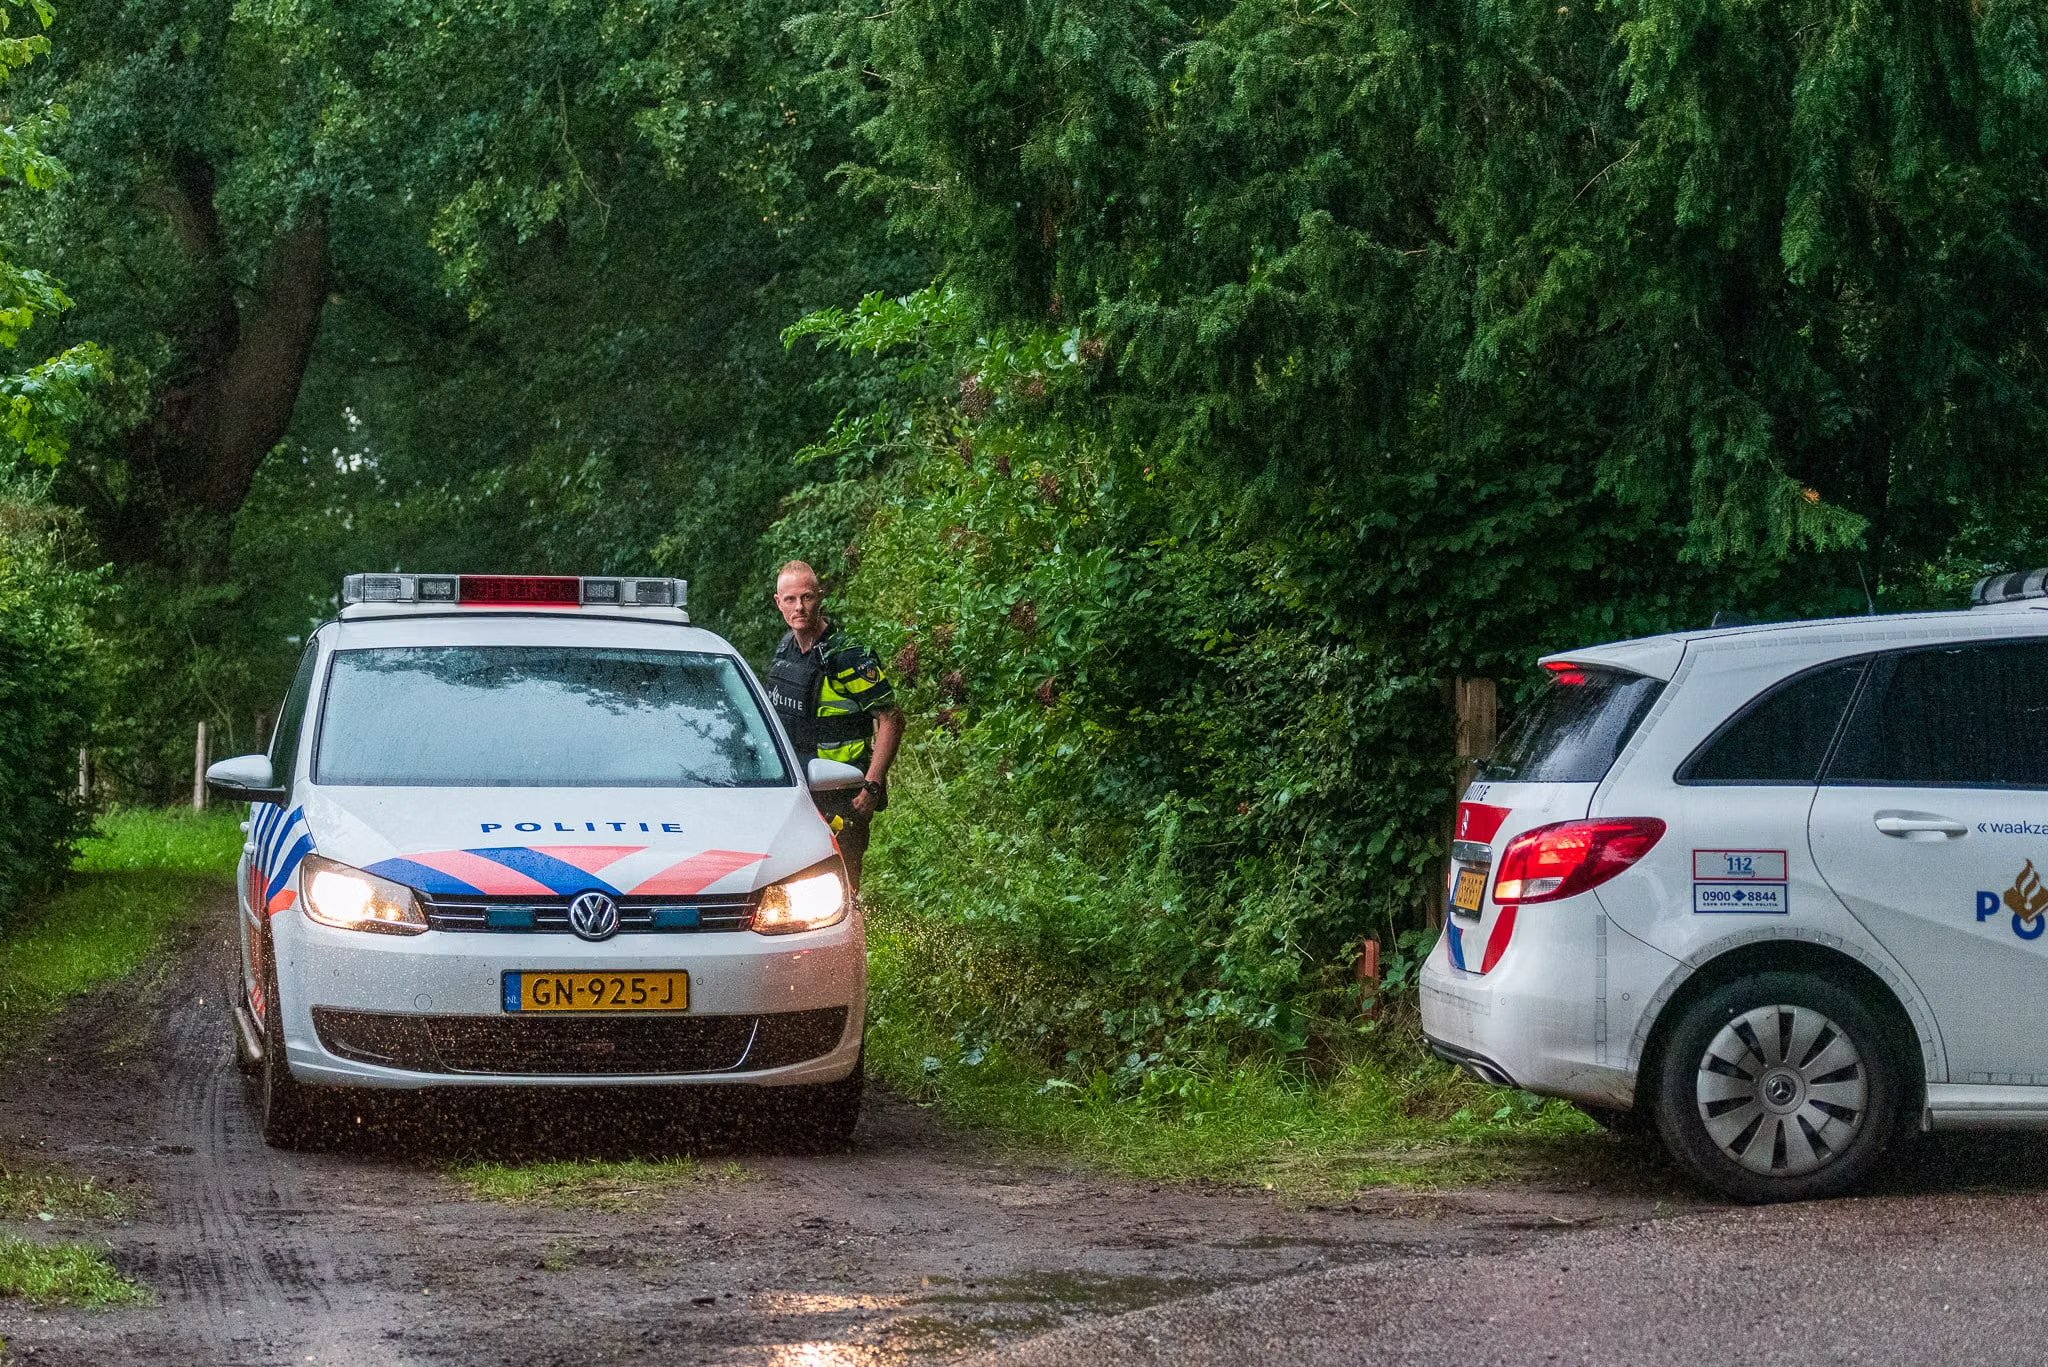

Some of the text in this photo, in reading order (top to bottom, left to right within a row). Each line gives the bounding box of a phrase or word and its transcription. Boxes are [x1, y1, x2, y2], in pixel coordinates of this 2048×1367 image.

[480, 822, 684, 833] POLITIE
[1702, 891, 1777, 902] 0900 8844
[506, 977, 674, 1005] NL GN-925-J
